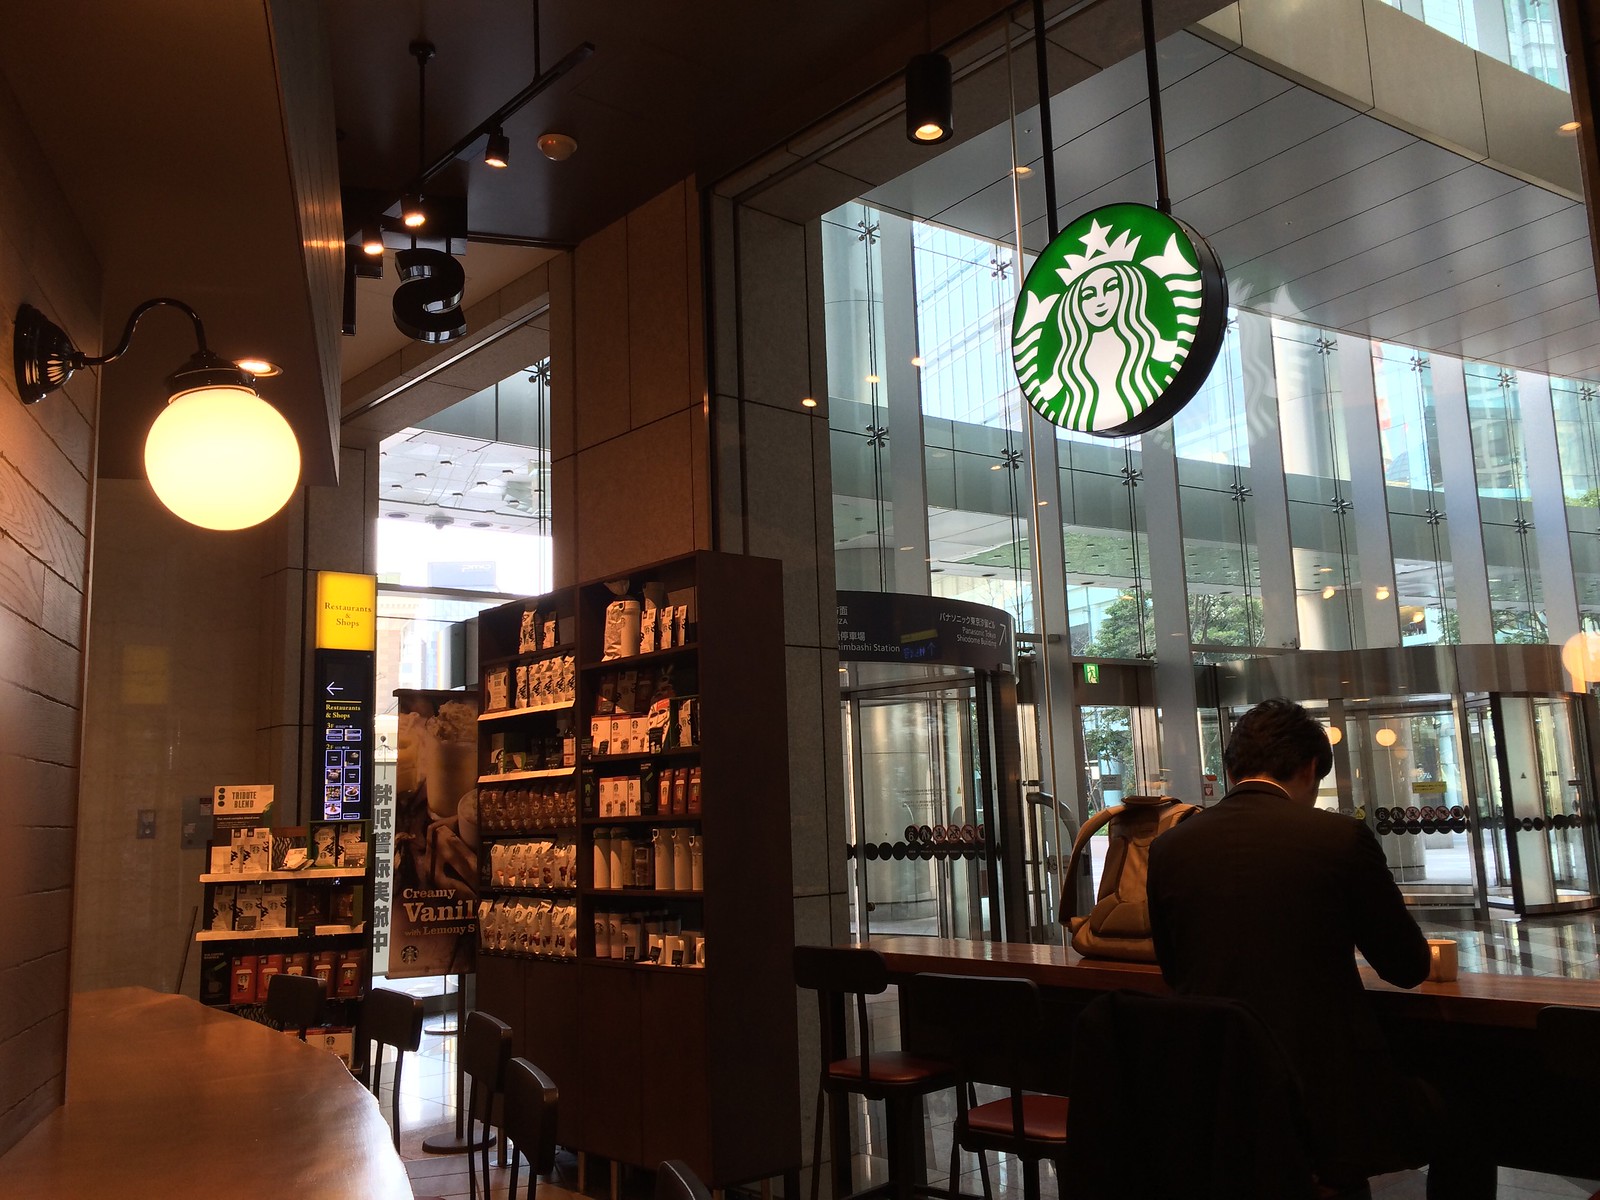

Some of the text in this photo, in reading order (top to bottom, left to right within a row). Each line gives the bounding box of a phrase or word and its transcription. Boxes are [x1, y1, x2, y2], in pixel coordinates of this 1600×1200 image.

[324, 602, 372, 613] Restaurants
[336, 618, 360, 628] Shops
[962, 626, 985, 637] Panasonic
[956, 633, 981, 645] Shiodome
[873, 643, 901, 652] Station
[325, 703, 361, 712] Restaurants
[332, 712, 351, 720] Shops
[232, 791, 257, 800] TRIBUTE
[234, 800, 254, 808] BLEND
[402, 888, 456, 900] Creamy
[402, 899, 477, 923] Vanil
[404, 928, 422, 936] with
[423, 926, 466, 936] Lemony
